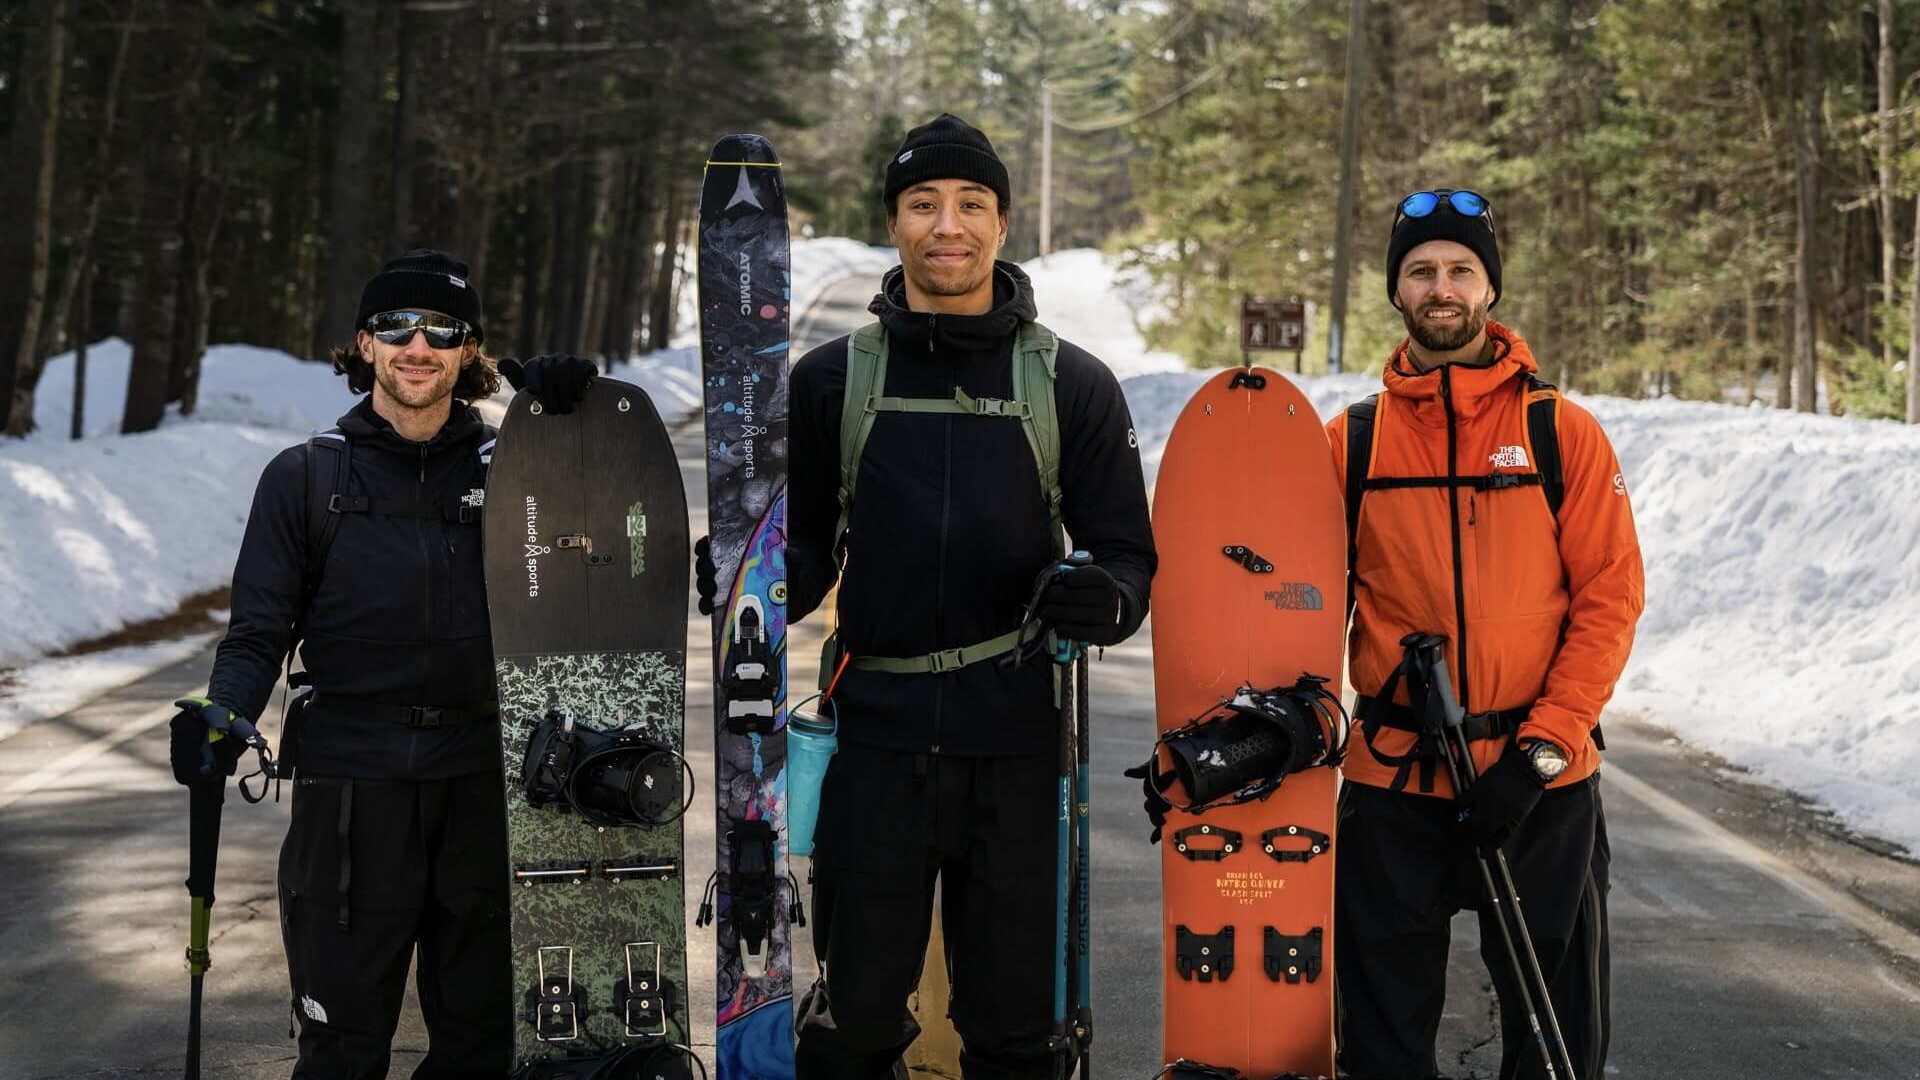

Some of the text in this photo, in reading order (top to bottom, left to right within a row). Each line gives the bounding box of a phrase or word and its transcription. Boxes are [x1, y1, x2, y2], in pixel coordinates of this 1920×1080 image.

[739, 251, 751, 316] ATOMIC
[742, 375, 756, 479] altitude sports
[525, 495, 540, 598] altitude sports
[1264, 590, 1304, 601] NORTH
[1275, 600, 1304, 610] FACE
[1281, 583, 1304, 593] THE
